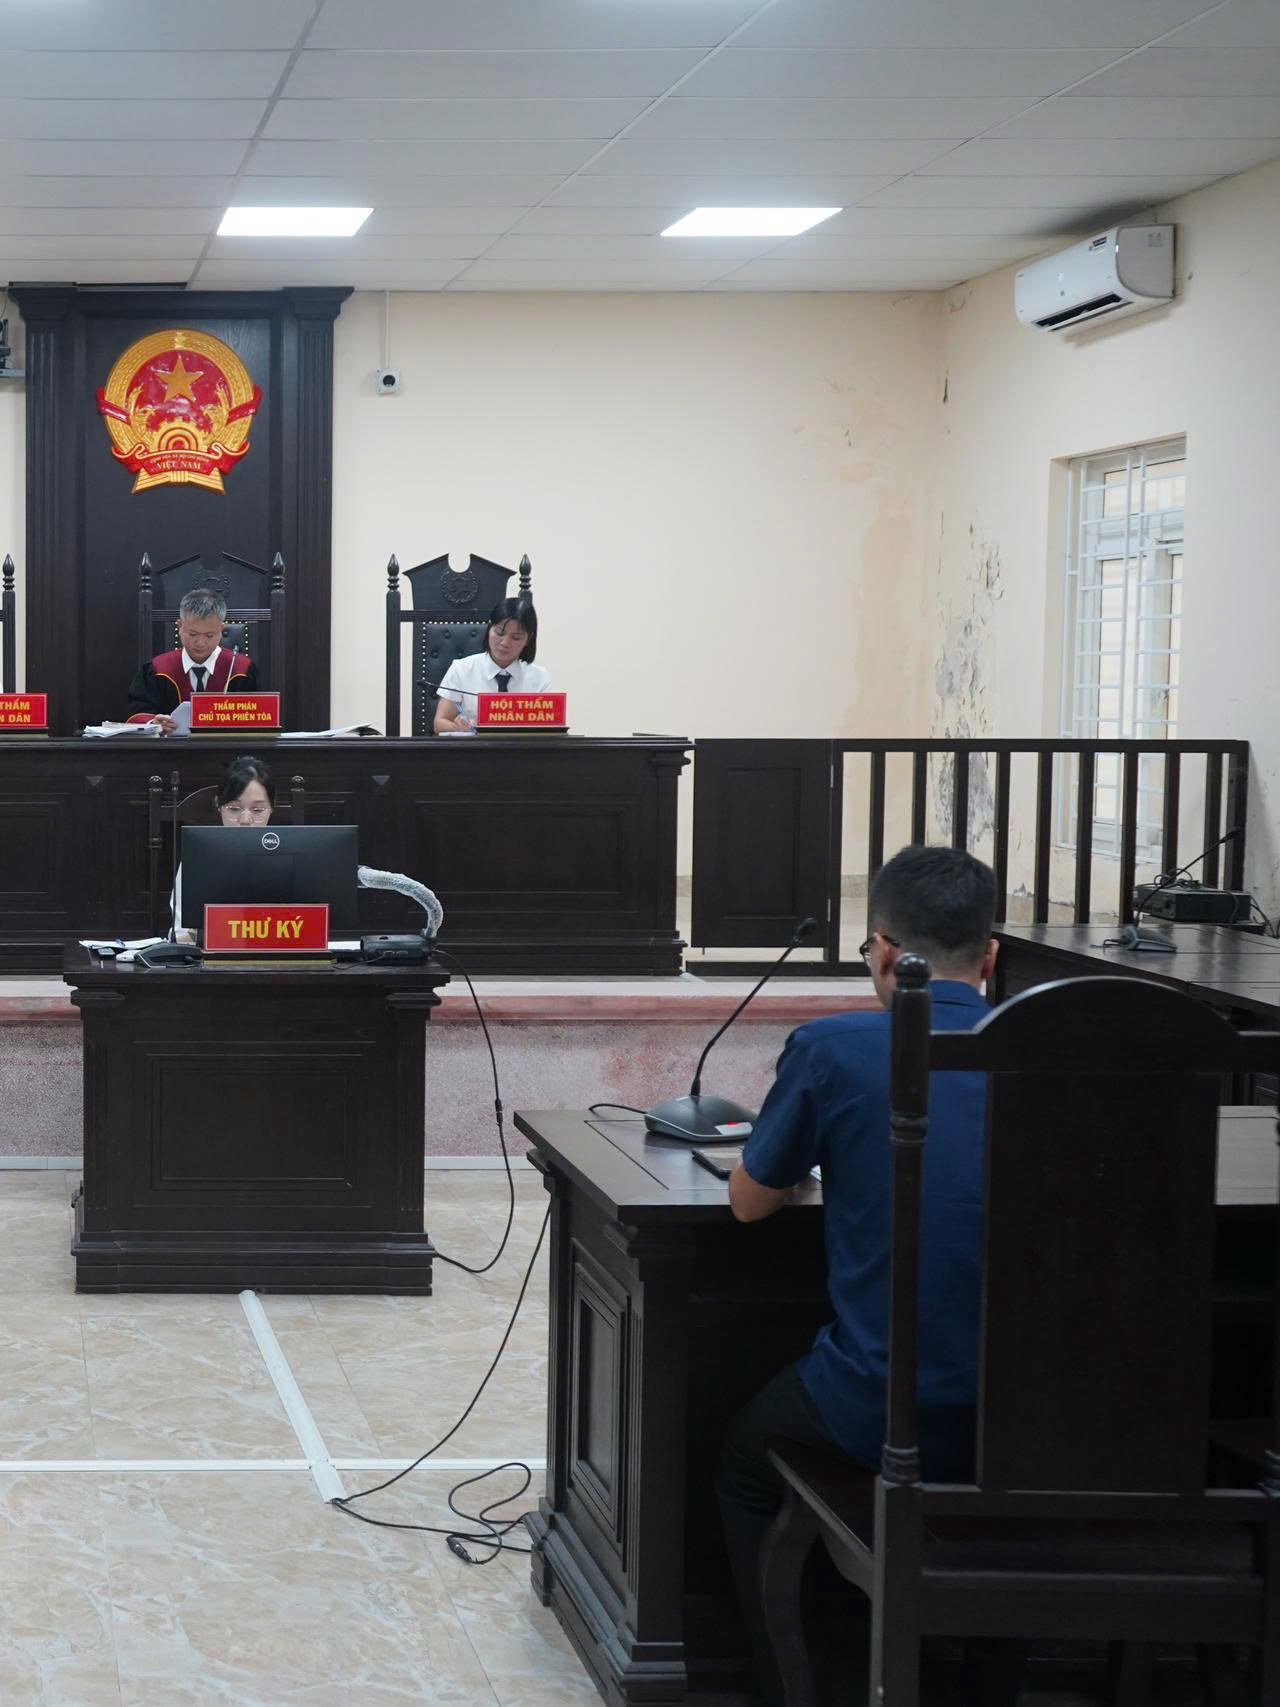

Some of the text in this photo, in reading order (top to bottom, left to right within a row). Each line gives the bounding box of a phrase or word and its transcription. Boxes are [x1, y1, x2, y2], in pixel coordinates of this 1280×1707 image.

[180, 460, 200, 470] NAM
[214, 699, 257, 710] THẨM PHÁN
[490, 697, 553, 710] HỘI THẨM
[8, 713, 31, 723] DÂN
[199, 711, 272, 722] CHỦ TỌA PHIÊN TÒA
[489, 711, 554, 721] NHÂN DÂN
[228, 916, 304, 938] THƯ KÝ
